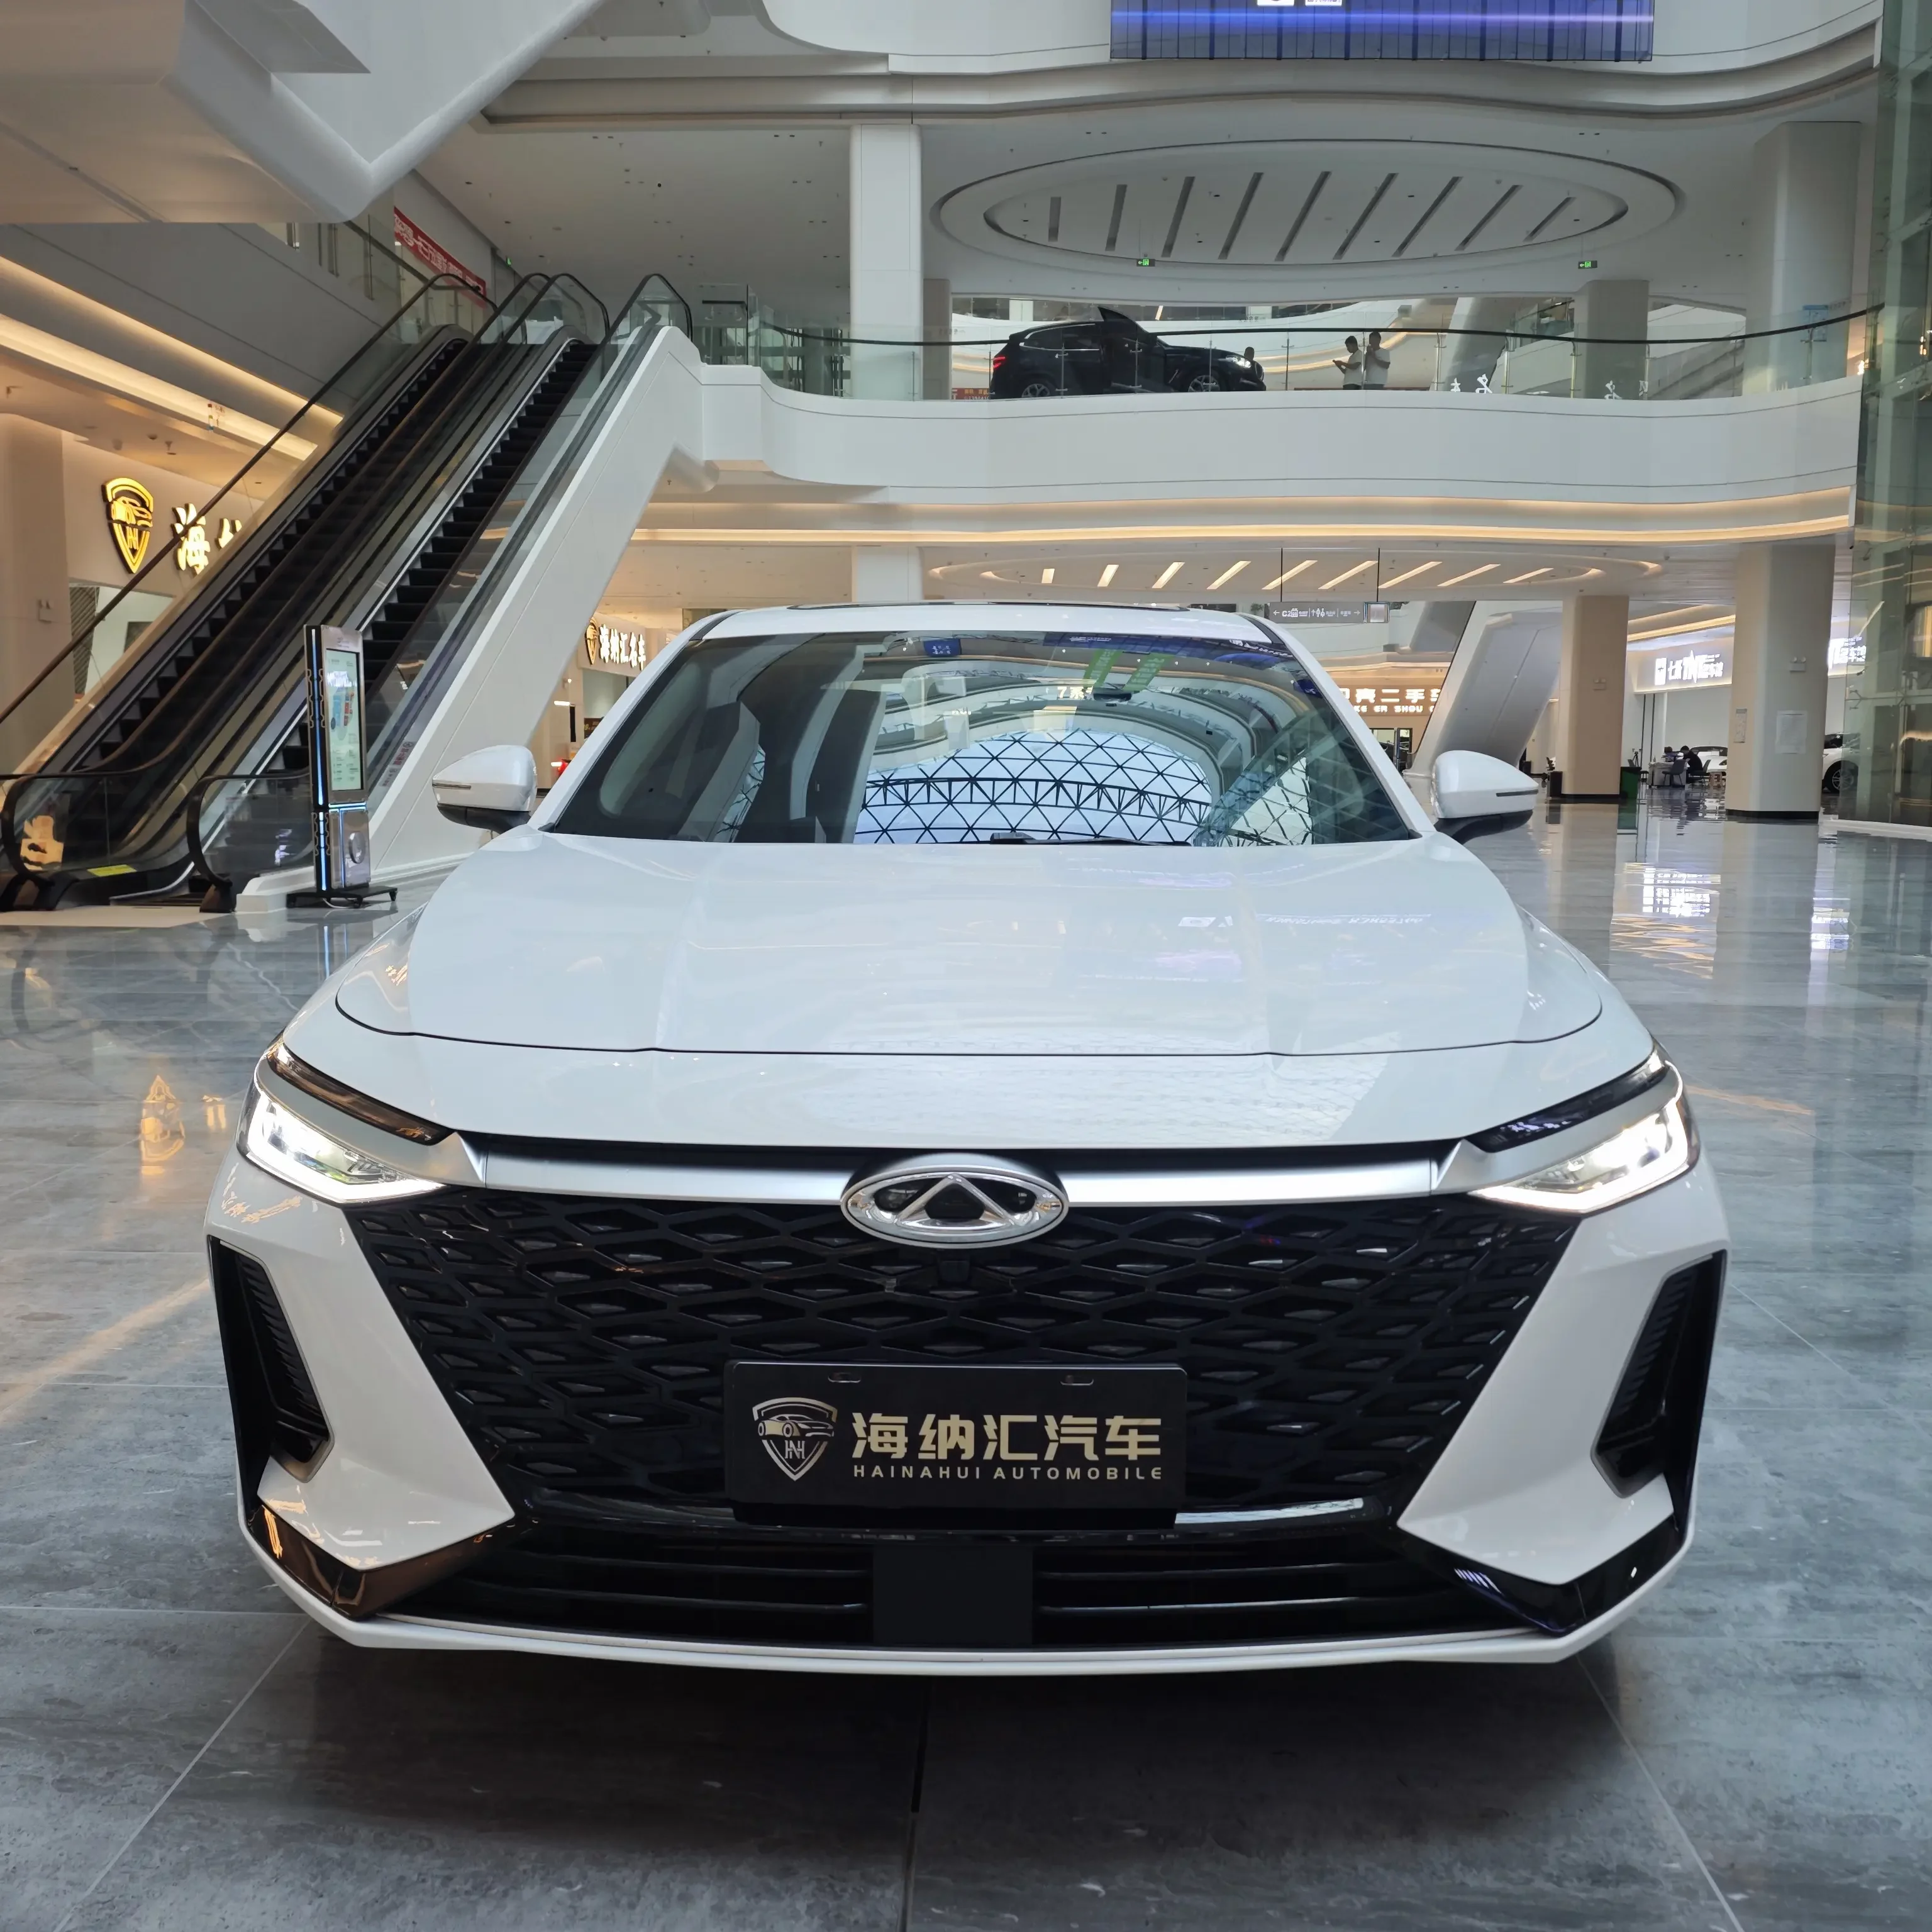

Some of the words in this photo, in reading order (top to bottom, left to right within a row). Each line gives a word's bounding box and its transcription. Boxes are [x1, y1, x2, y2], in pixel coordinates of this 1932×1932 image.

[599, 623, 647, 671] 海纳汇名车
[852, 1412, 1162, 1461] 海纳汇汽车
[853, 1465, 980, 1479] HAINAHUI
[993, 1467, 1162, 1480] AUTOMOBILE
